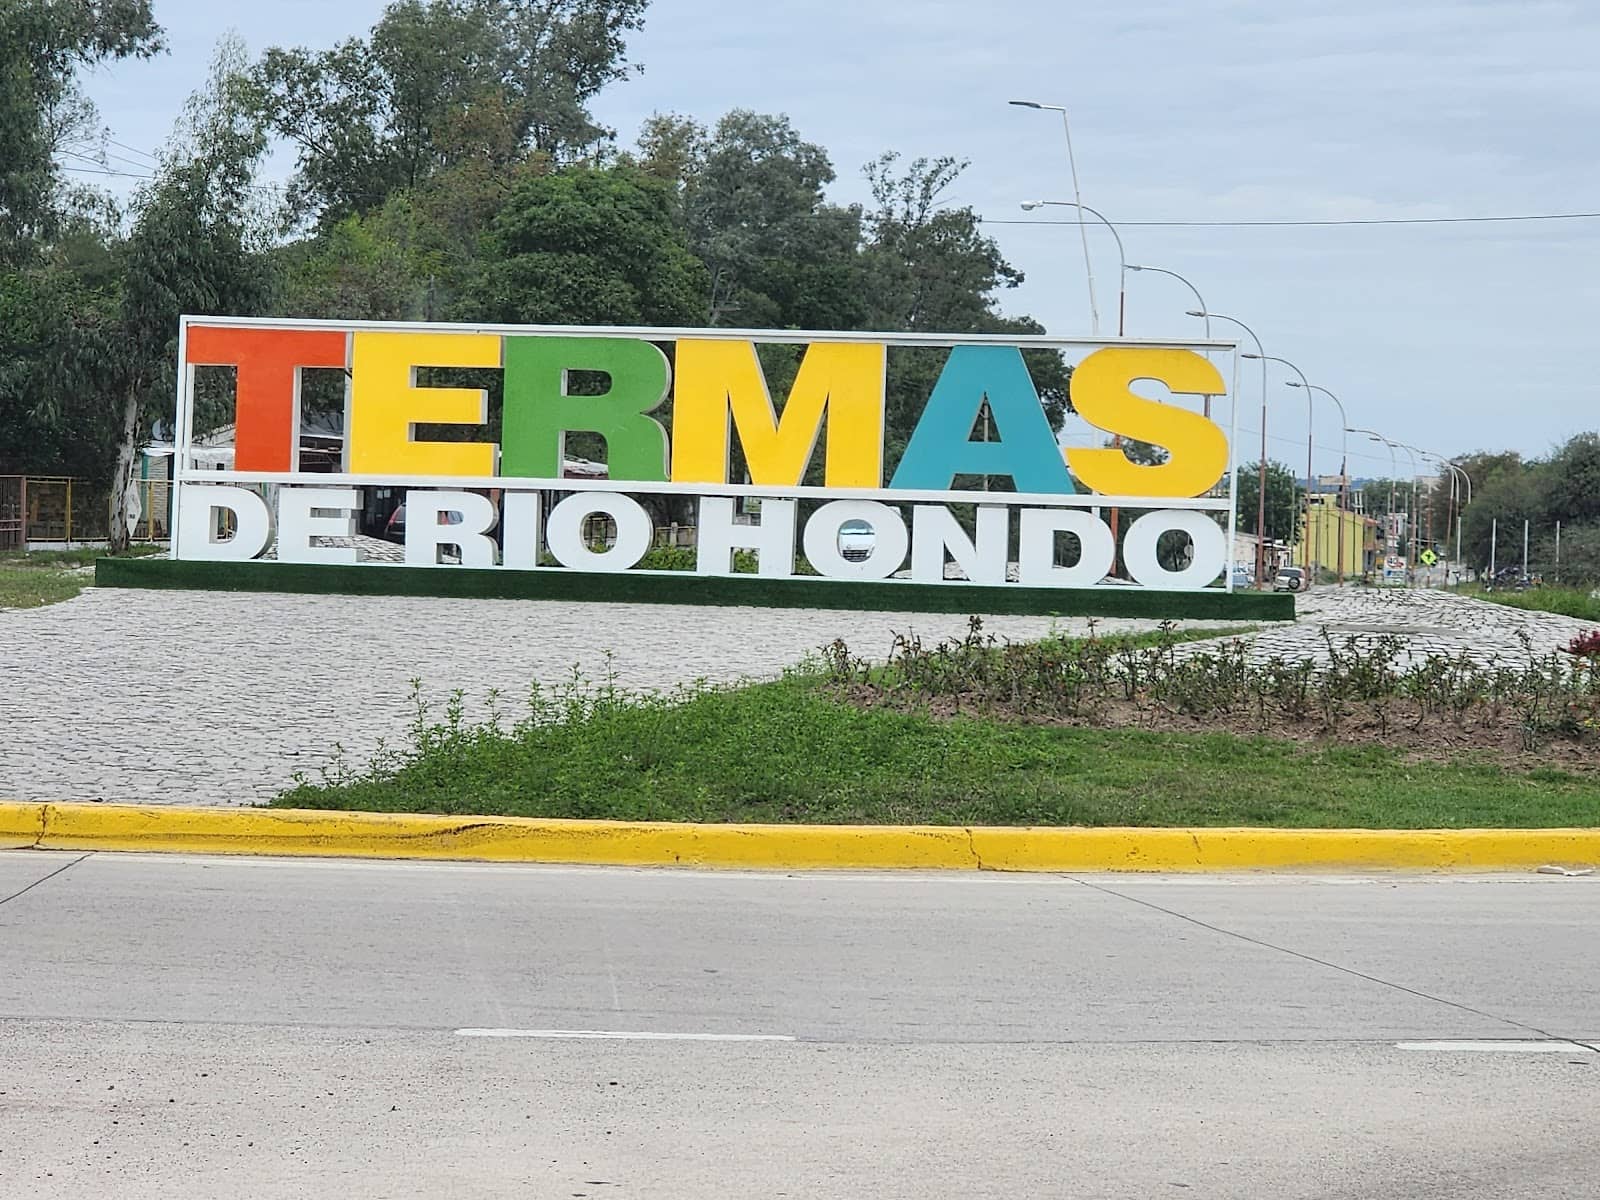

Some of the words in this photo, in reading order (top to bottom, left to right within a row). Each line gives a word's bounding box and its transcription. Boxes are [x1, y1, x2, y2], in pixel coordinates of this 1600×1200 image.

[186, 326, 1230, 498] TERMAS
[176, 485, 361, 563] DE
[404, 490, 654, 571] RIO
[696, 496, 1228, 589] HONDO
